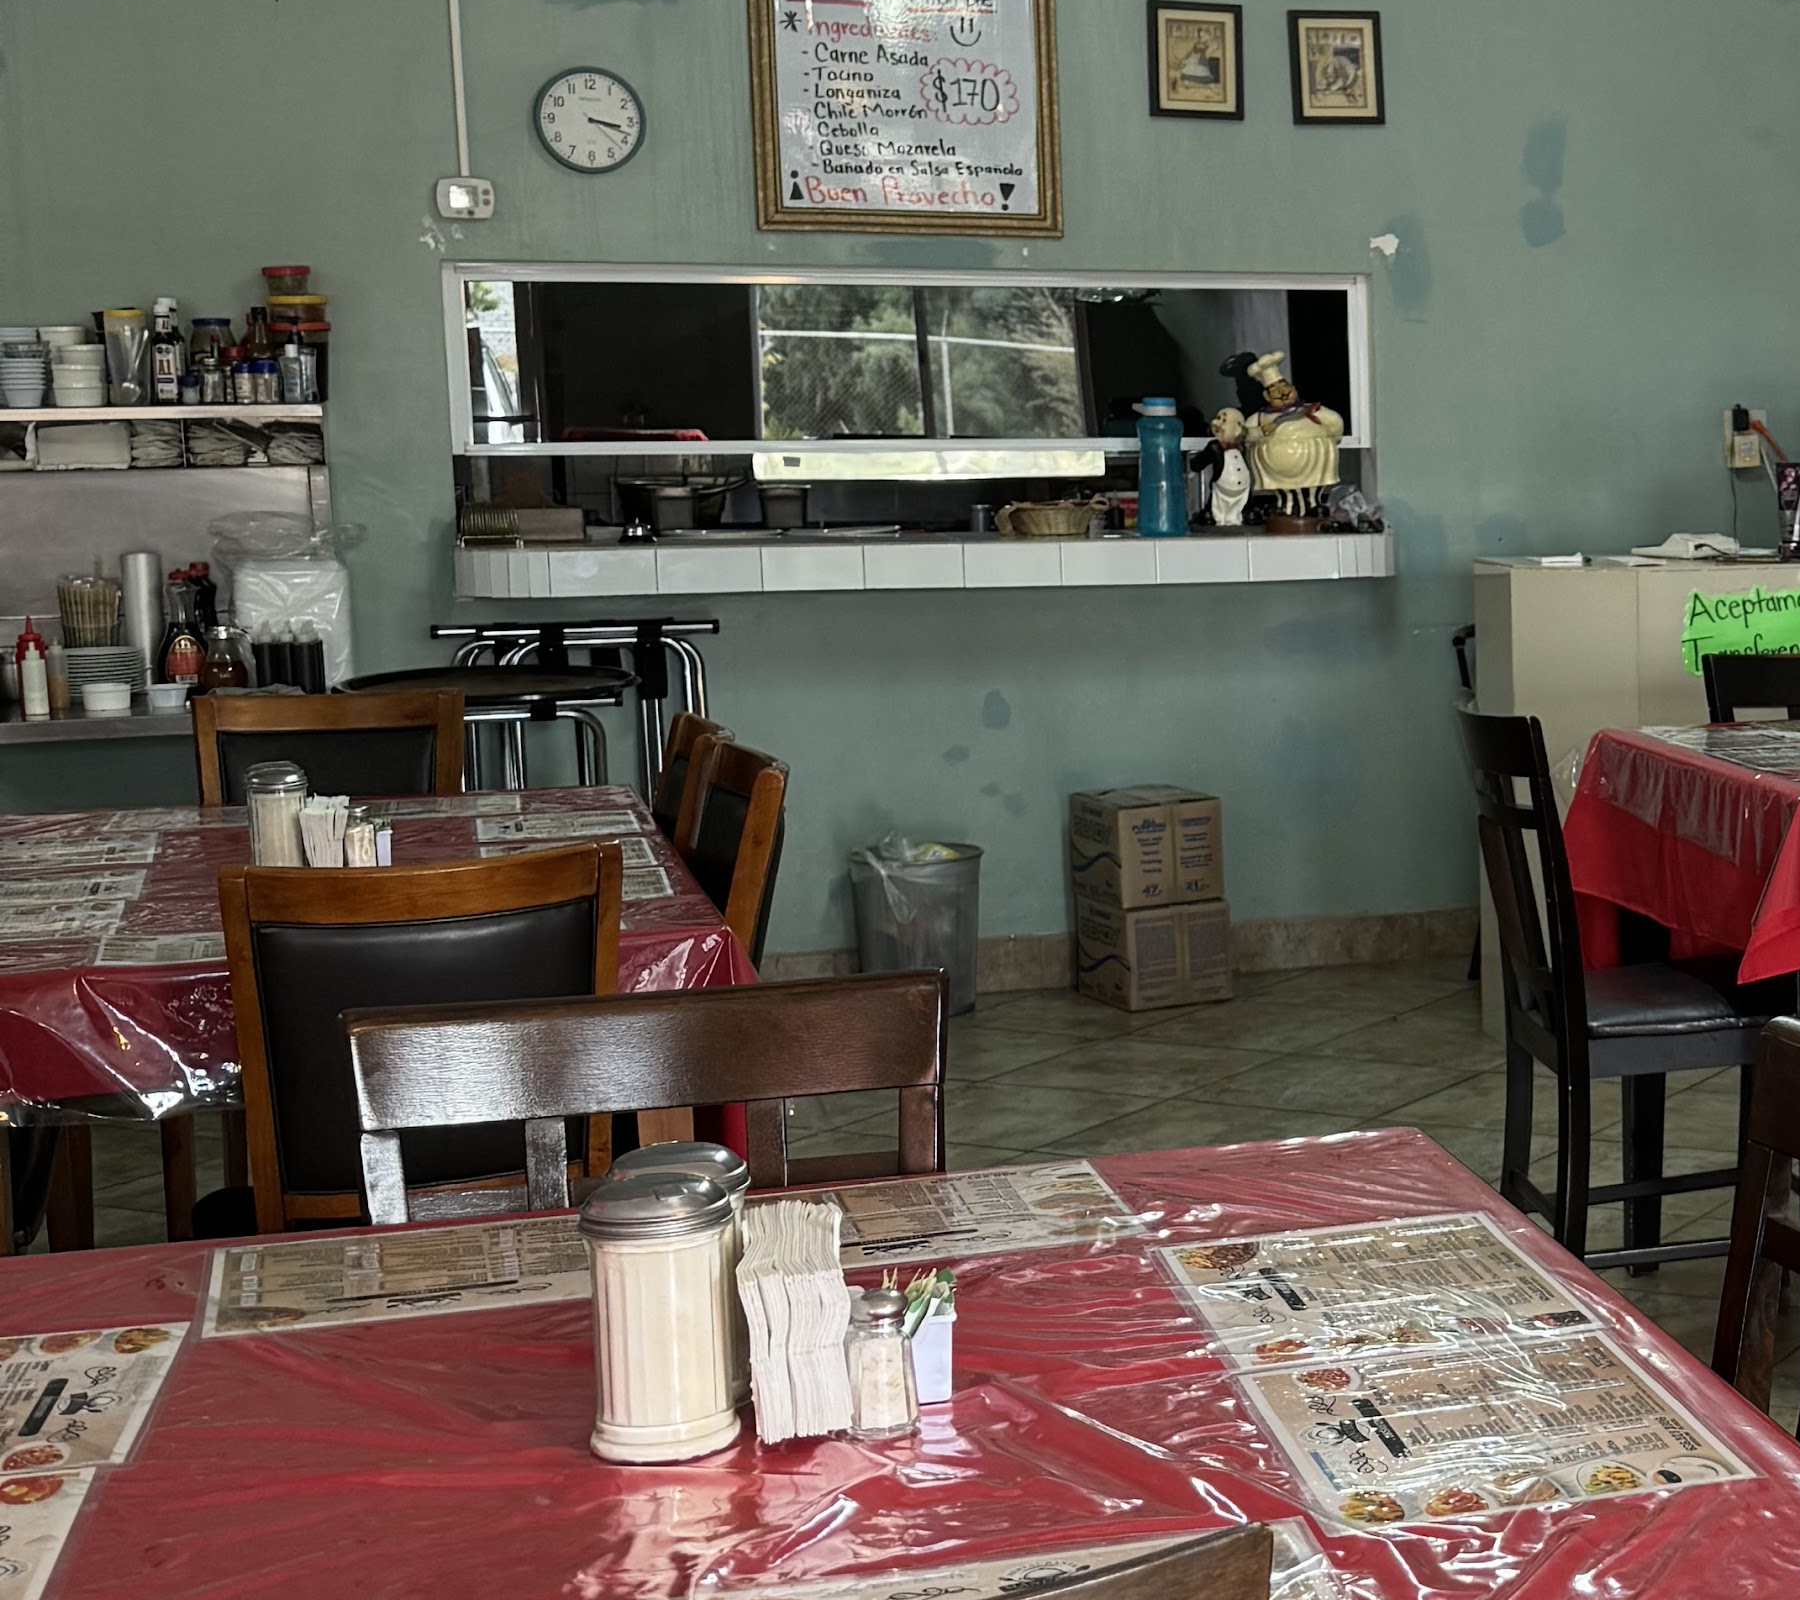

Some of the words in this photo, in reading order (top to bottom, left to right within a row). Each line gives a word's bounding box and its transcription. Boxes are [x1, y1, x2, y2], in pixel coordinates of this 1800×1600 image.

[814, 41, 870, 66] Carne
[876, 44, 929, 67] Asada
[811, 65, 874, 83] Tocino
[568, 82, 576, 94] 11
[584, 78, 596, 90] 12
[814, 83, 902, 107] Longaniza
[932, 68, 1000, 114] $170
[553, 95, 565, 107] 10
[620, 98, 628, 110] 2
[813, 101, 857, 120] Chile
[547, 112, 556, 124] 9
[626, 116, 635, 129] 3
[817, 121, 879, 139] Cebolla
[554, 131, 562, 143] 8
[568, 144, 577, 156] 7
[607, 147, 615, 159] 5
[877, 138, 957, 157] Mozarela
[588, 150, 596, 161] 6
[888, 165, 905, 176] en
[910, 159, 949, 177] Salsa
